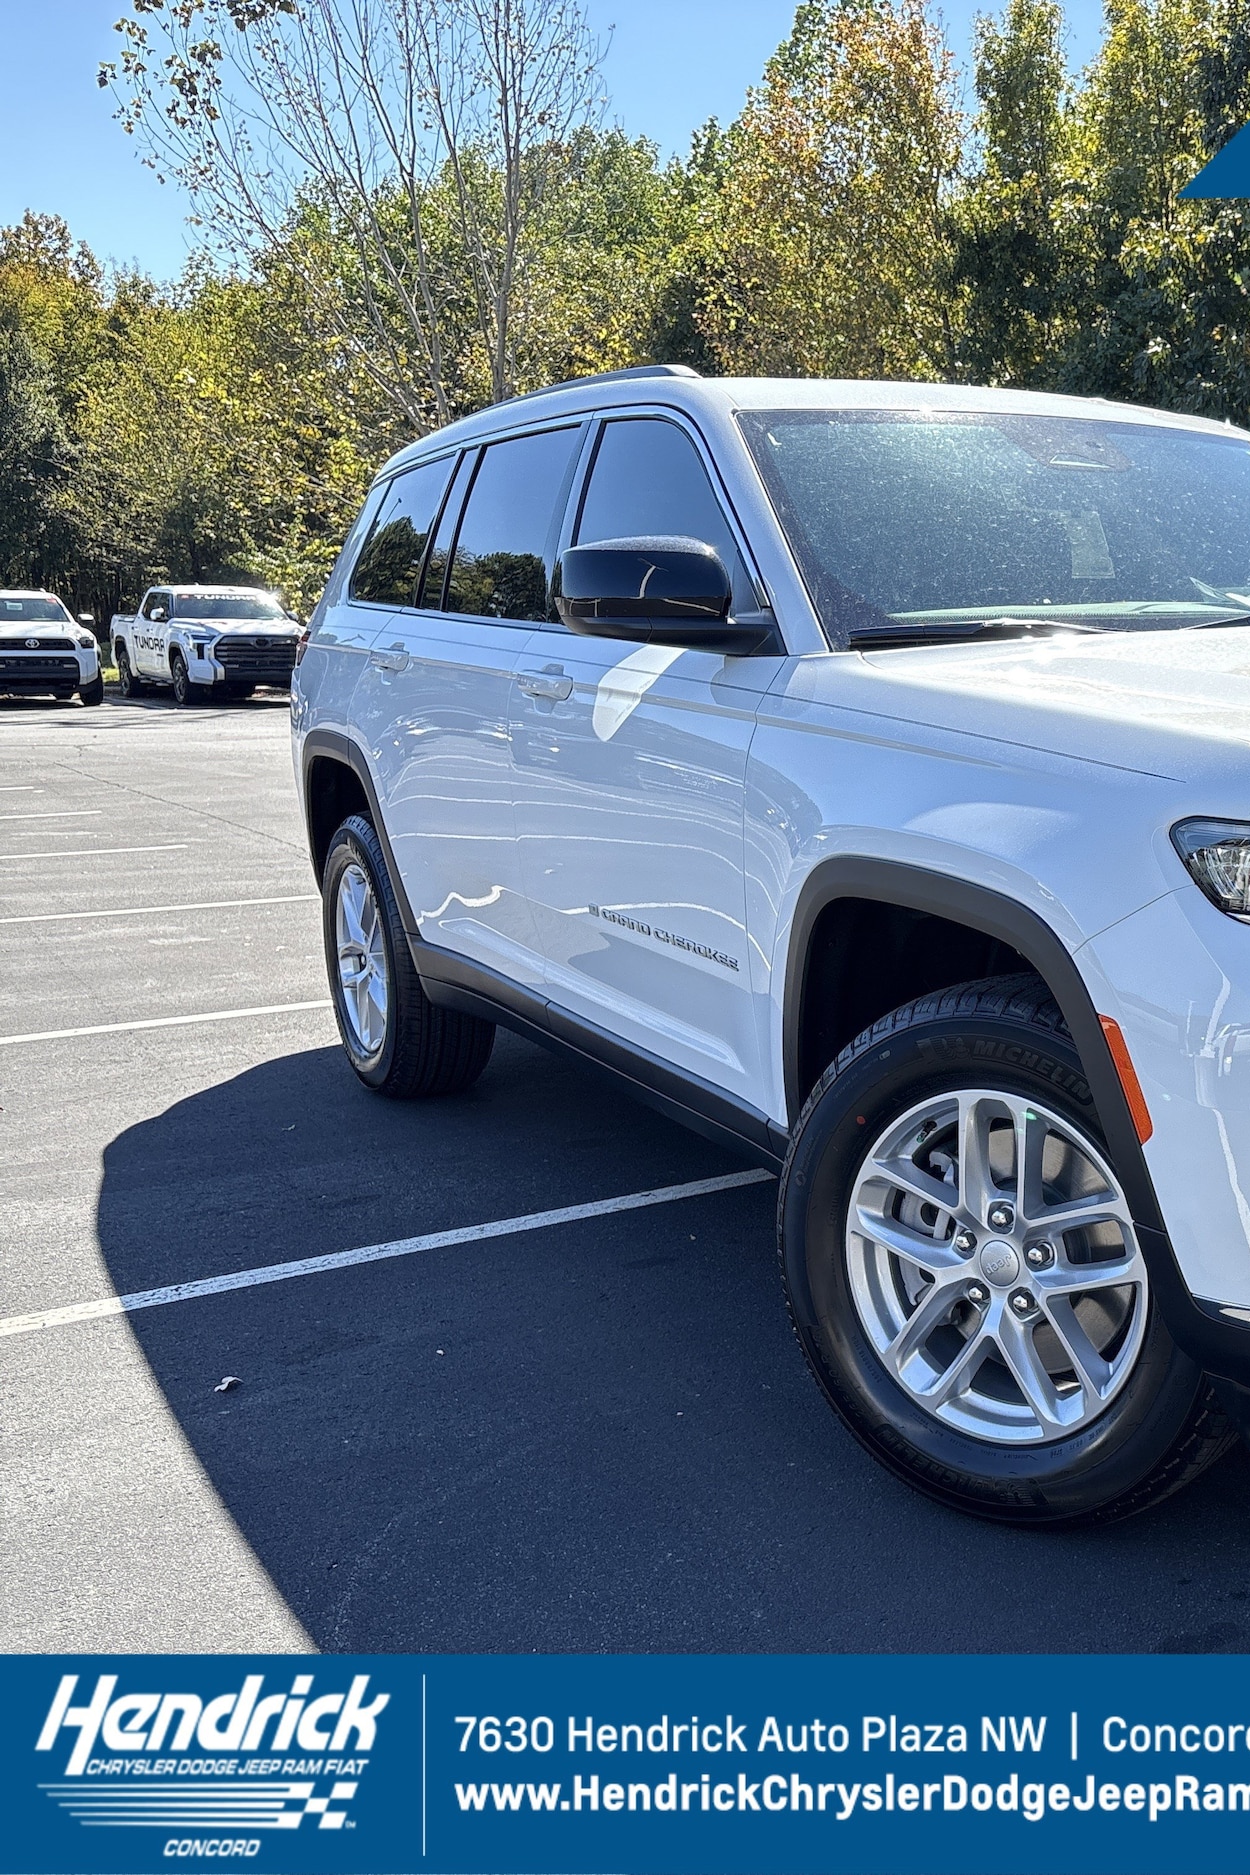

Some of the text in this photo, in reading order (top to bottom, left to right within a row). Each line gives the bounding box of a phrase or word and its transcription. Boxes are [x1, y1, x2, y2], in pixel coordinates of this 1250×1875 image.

[134, 634, 165, 651] TUNDRA
[601, 908, 740, 972] GRAND CHEROKEE
[973, 1040, 1092, 1102] MICHELIN
